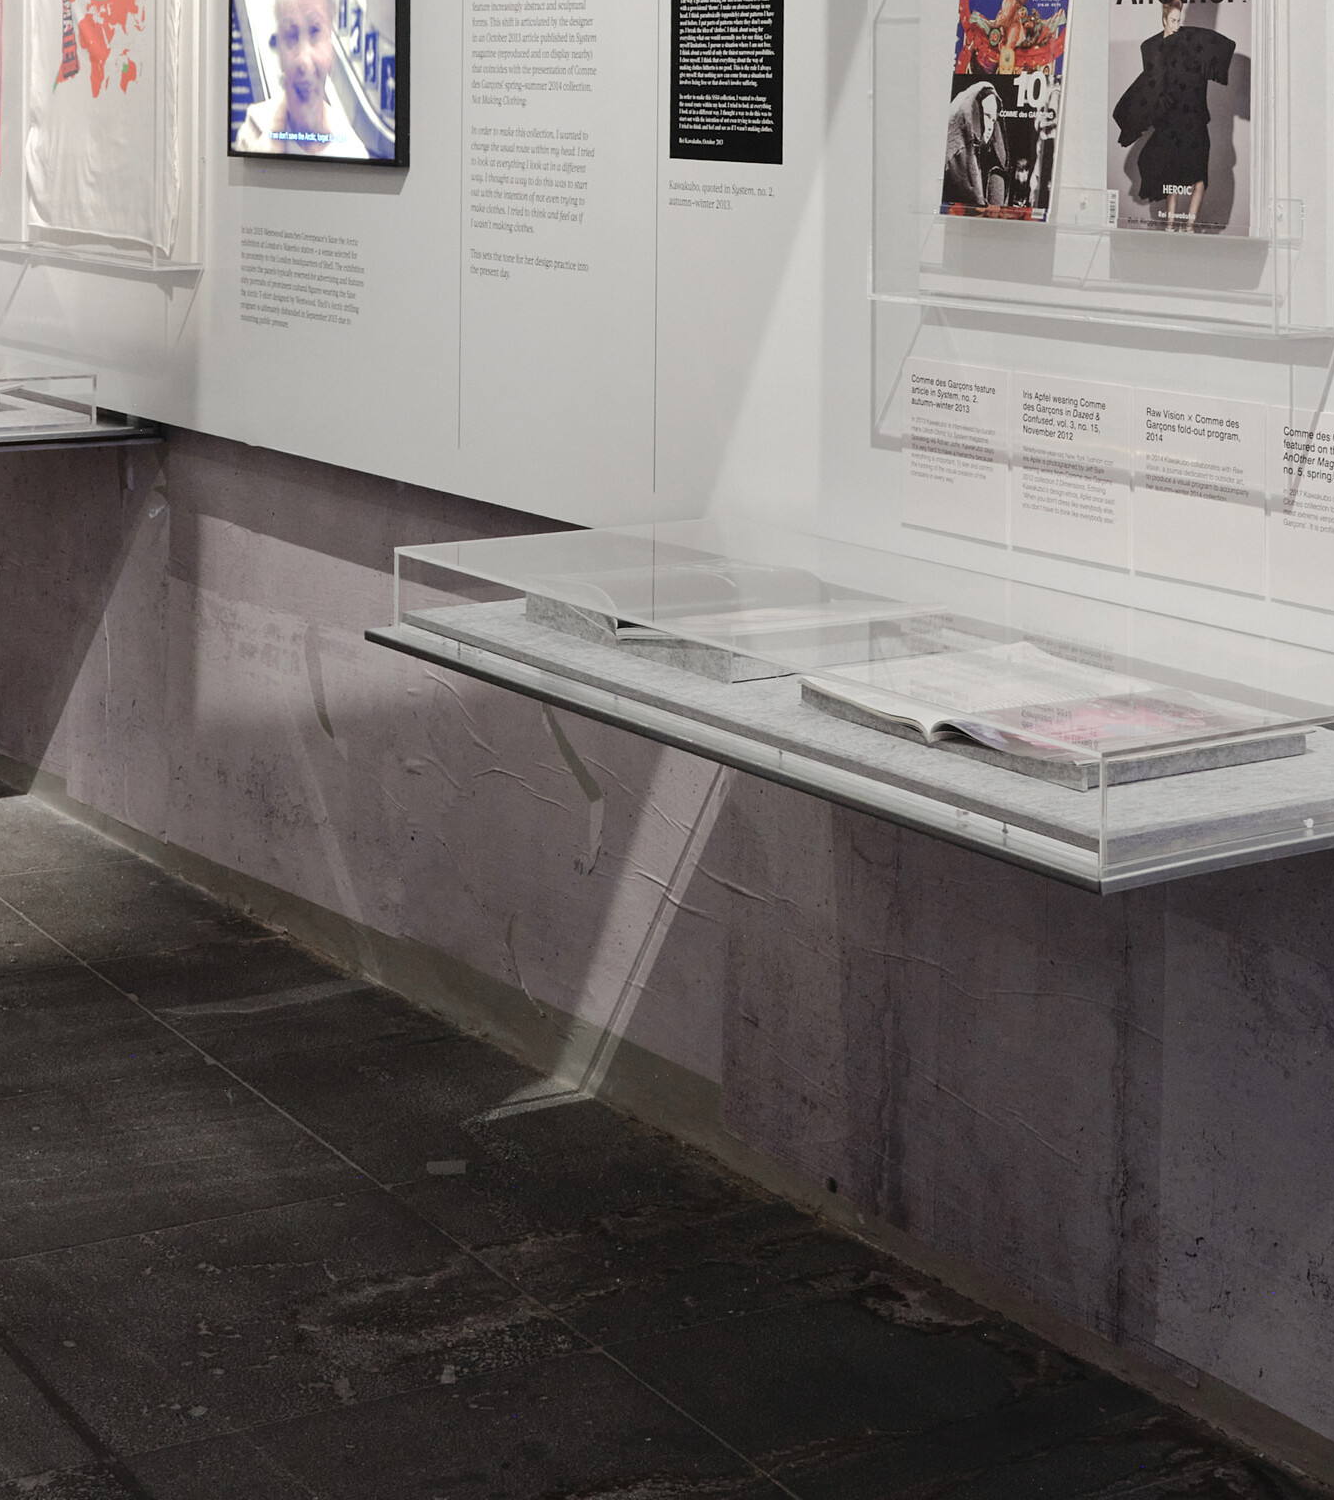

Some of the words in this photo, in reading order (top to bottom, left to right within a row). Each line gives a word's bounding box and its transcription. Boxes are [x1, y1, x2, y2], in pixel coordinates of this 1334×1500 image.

[1013, 71, 1047, 107] 10
[1162, 184, 1192, 195] HEROIC
[1023, 391, 1032, 399] Iris
[1035, 392, 1050, 402] Apfel
[1053, 397, 1078, 408] wearing
[1080, 398, 1105, 410] Comme
[1284, 426, 1314, 439] Comme
[1316, 433, 1330, 441] des
